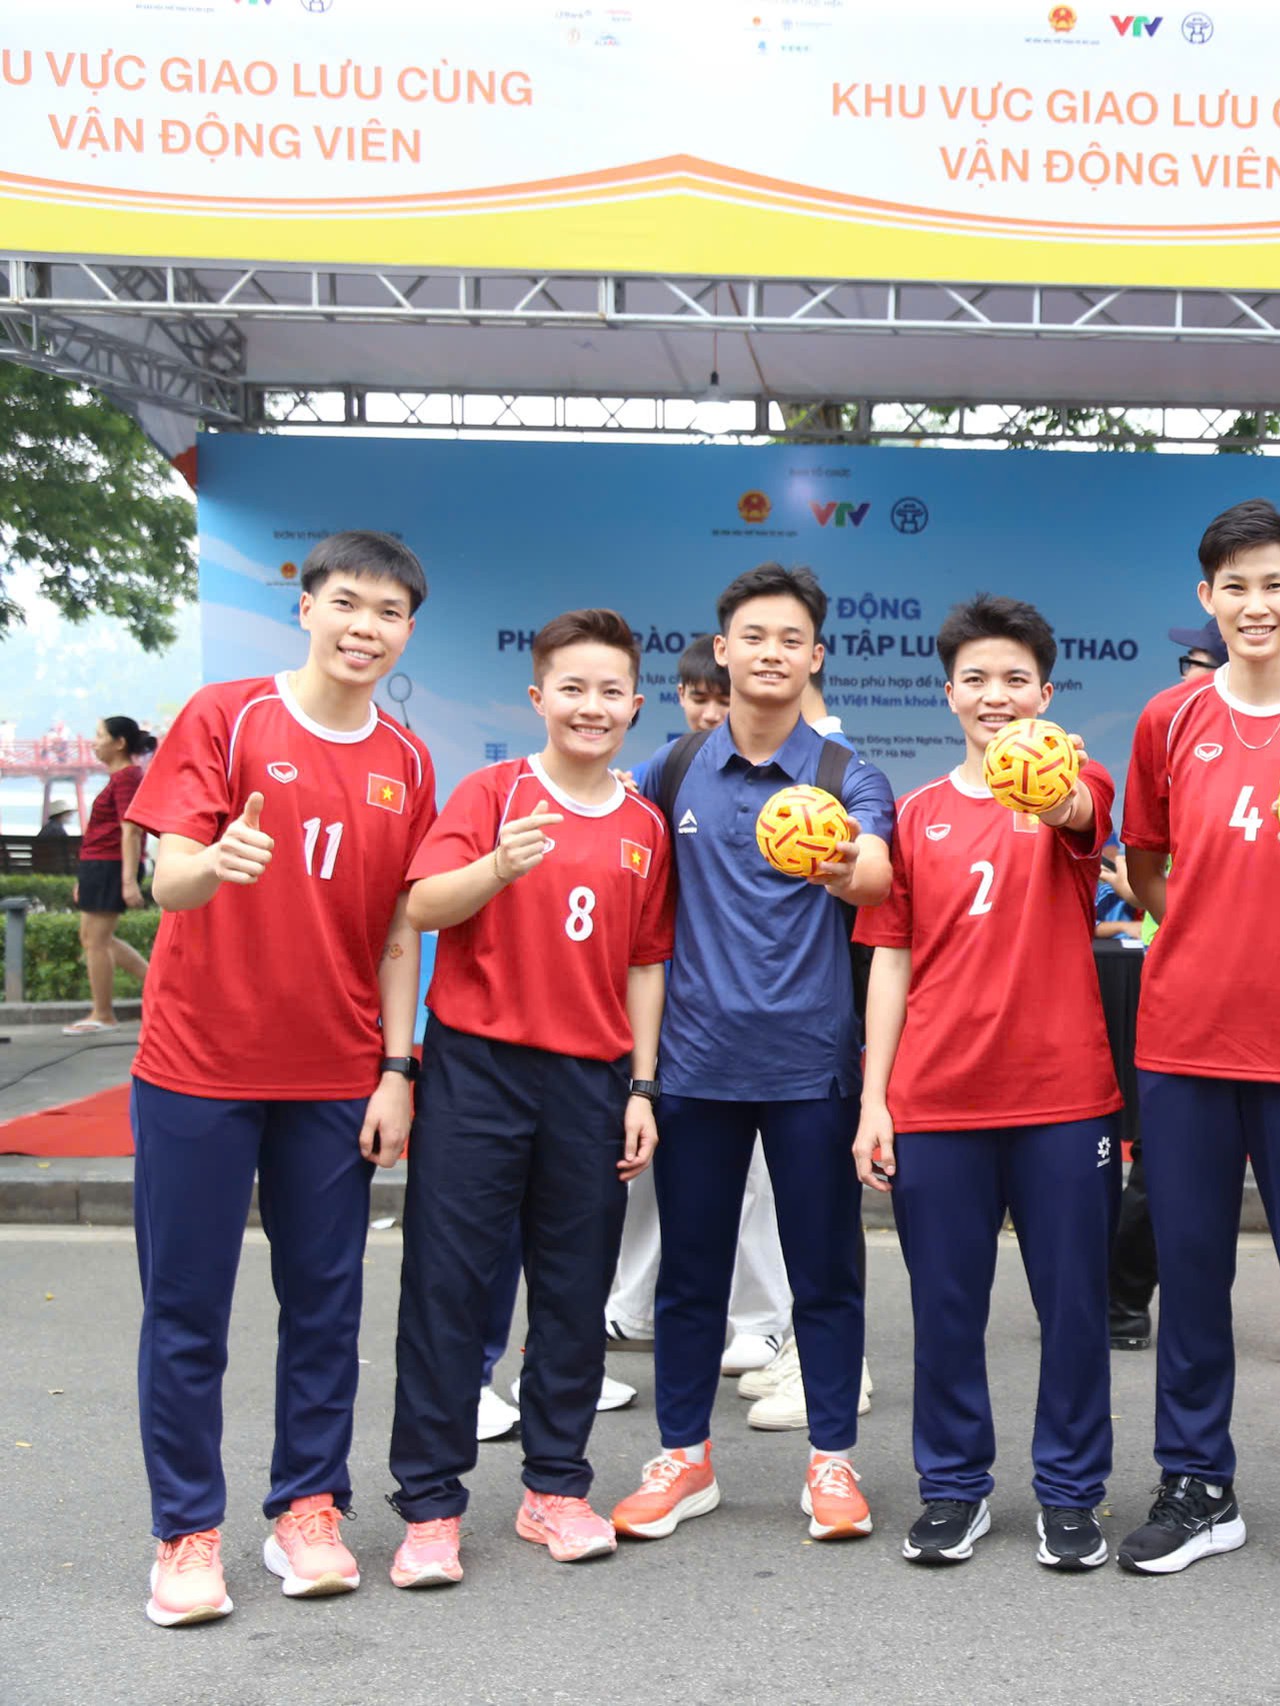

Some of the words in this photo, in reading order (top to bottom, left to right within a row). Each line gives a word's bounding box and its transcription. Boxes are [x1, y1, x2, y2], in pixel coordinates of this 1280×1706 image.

[1111, 15, 1163, 38] VTV
[45, 48, 145, 96] VỰC
[160, 56, 277, 97] GIAO
[293, 58, 382, 101] LƯU
[397, 59, 532, 106] CÙNG
[832, 82, 926, 120] KHU
[939, 82, 1033, 128] VỰC
[1046, 88, 1159, 127] GIAO
[1173, 88, 1258, 130] LƯU
[48, 106, 144, 158] VẬN
[159, 111, 301, 164] ĐỘNG
[314, 117, 421, 163] VIÊN
[940, 138, 1029, 191] VẬN
[1044, 141, 1179, 193] ĐỘNG
[808, 501, 871, 528] VTV
[836, 592, 922, 625] ĐỘNG
[841, 629, 896, 662] TẬP
[1059, 638, 1139, 661] THAO
[829, 675, 859, 688] thao
[842, 694, 868, 709] Việt
[871, 696, 902, 708] Nam
[1052, 679, 1083, 693] uyên
[1228, 785, 1263, 842] 4
[303, 817, 344, 880] 11
[967, 860, 995, 917] 2
[565, 886, 597, 942] 8
